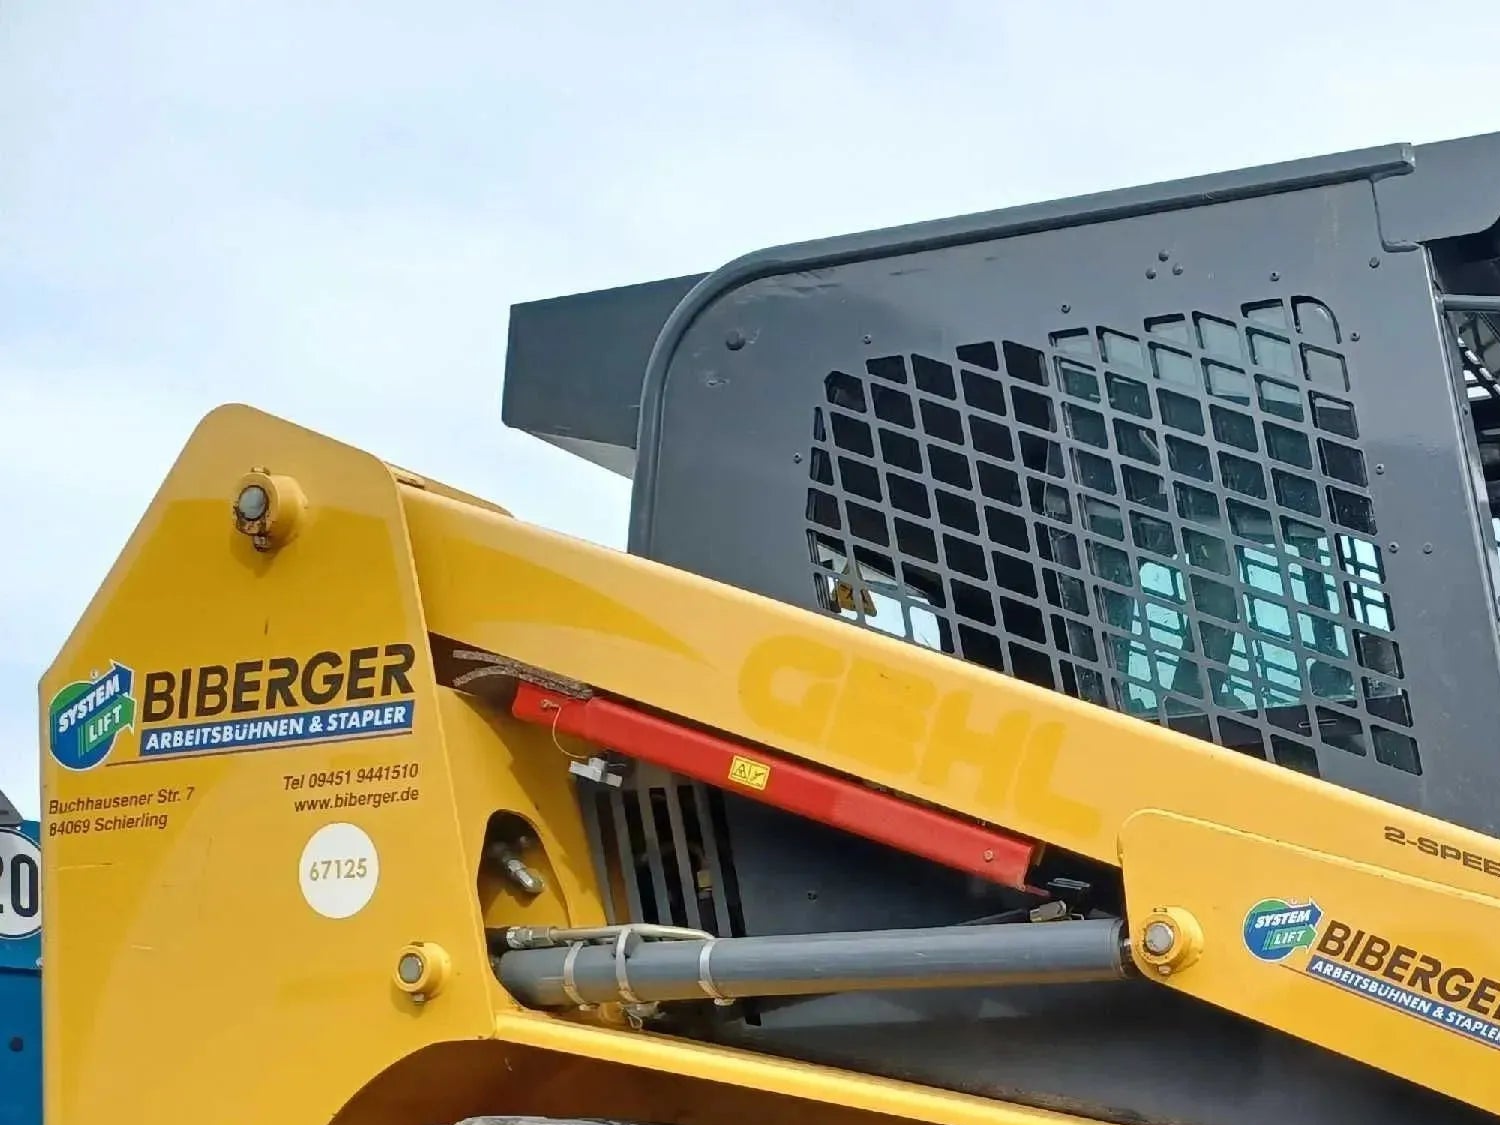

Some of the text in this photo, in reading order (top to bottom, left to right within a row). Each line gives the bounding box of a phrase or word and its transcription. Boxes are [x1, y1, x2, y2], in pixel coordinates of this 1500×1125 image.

[142, 643, 416, 723] BIBERGER
[59, 674, 120, 733] SYSTEM
[88, 704, 122, 743] LIFT
[145, 705, 408, 750] ARBEITSBÜHNEN & STAPLER
[738, 634, 1100, 838] GEHL
[309, 770, 351, 788] 09451
[357, 763, 419, 783] 9441510
[49, 786, 195, 815] Buchhausener Str. 7
[294, 787, 419, 812] www.biberger.de
[50, 812, 168, 837] 84069 Schierling
[309, 857, 368, 882] 67125
[1254, 909, 1312, 928] SYSTEM
[1273, 930, 1306, 945] LIFT
[1311, 960, 1432, 1014] ARBEITSBÜHNEN
[1432, 1006, 1445, 1019] &
